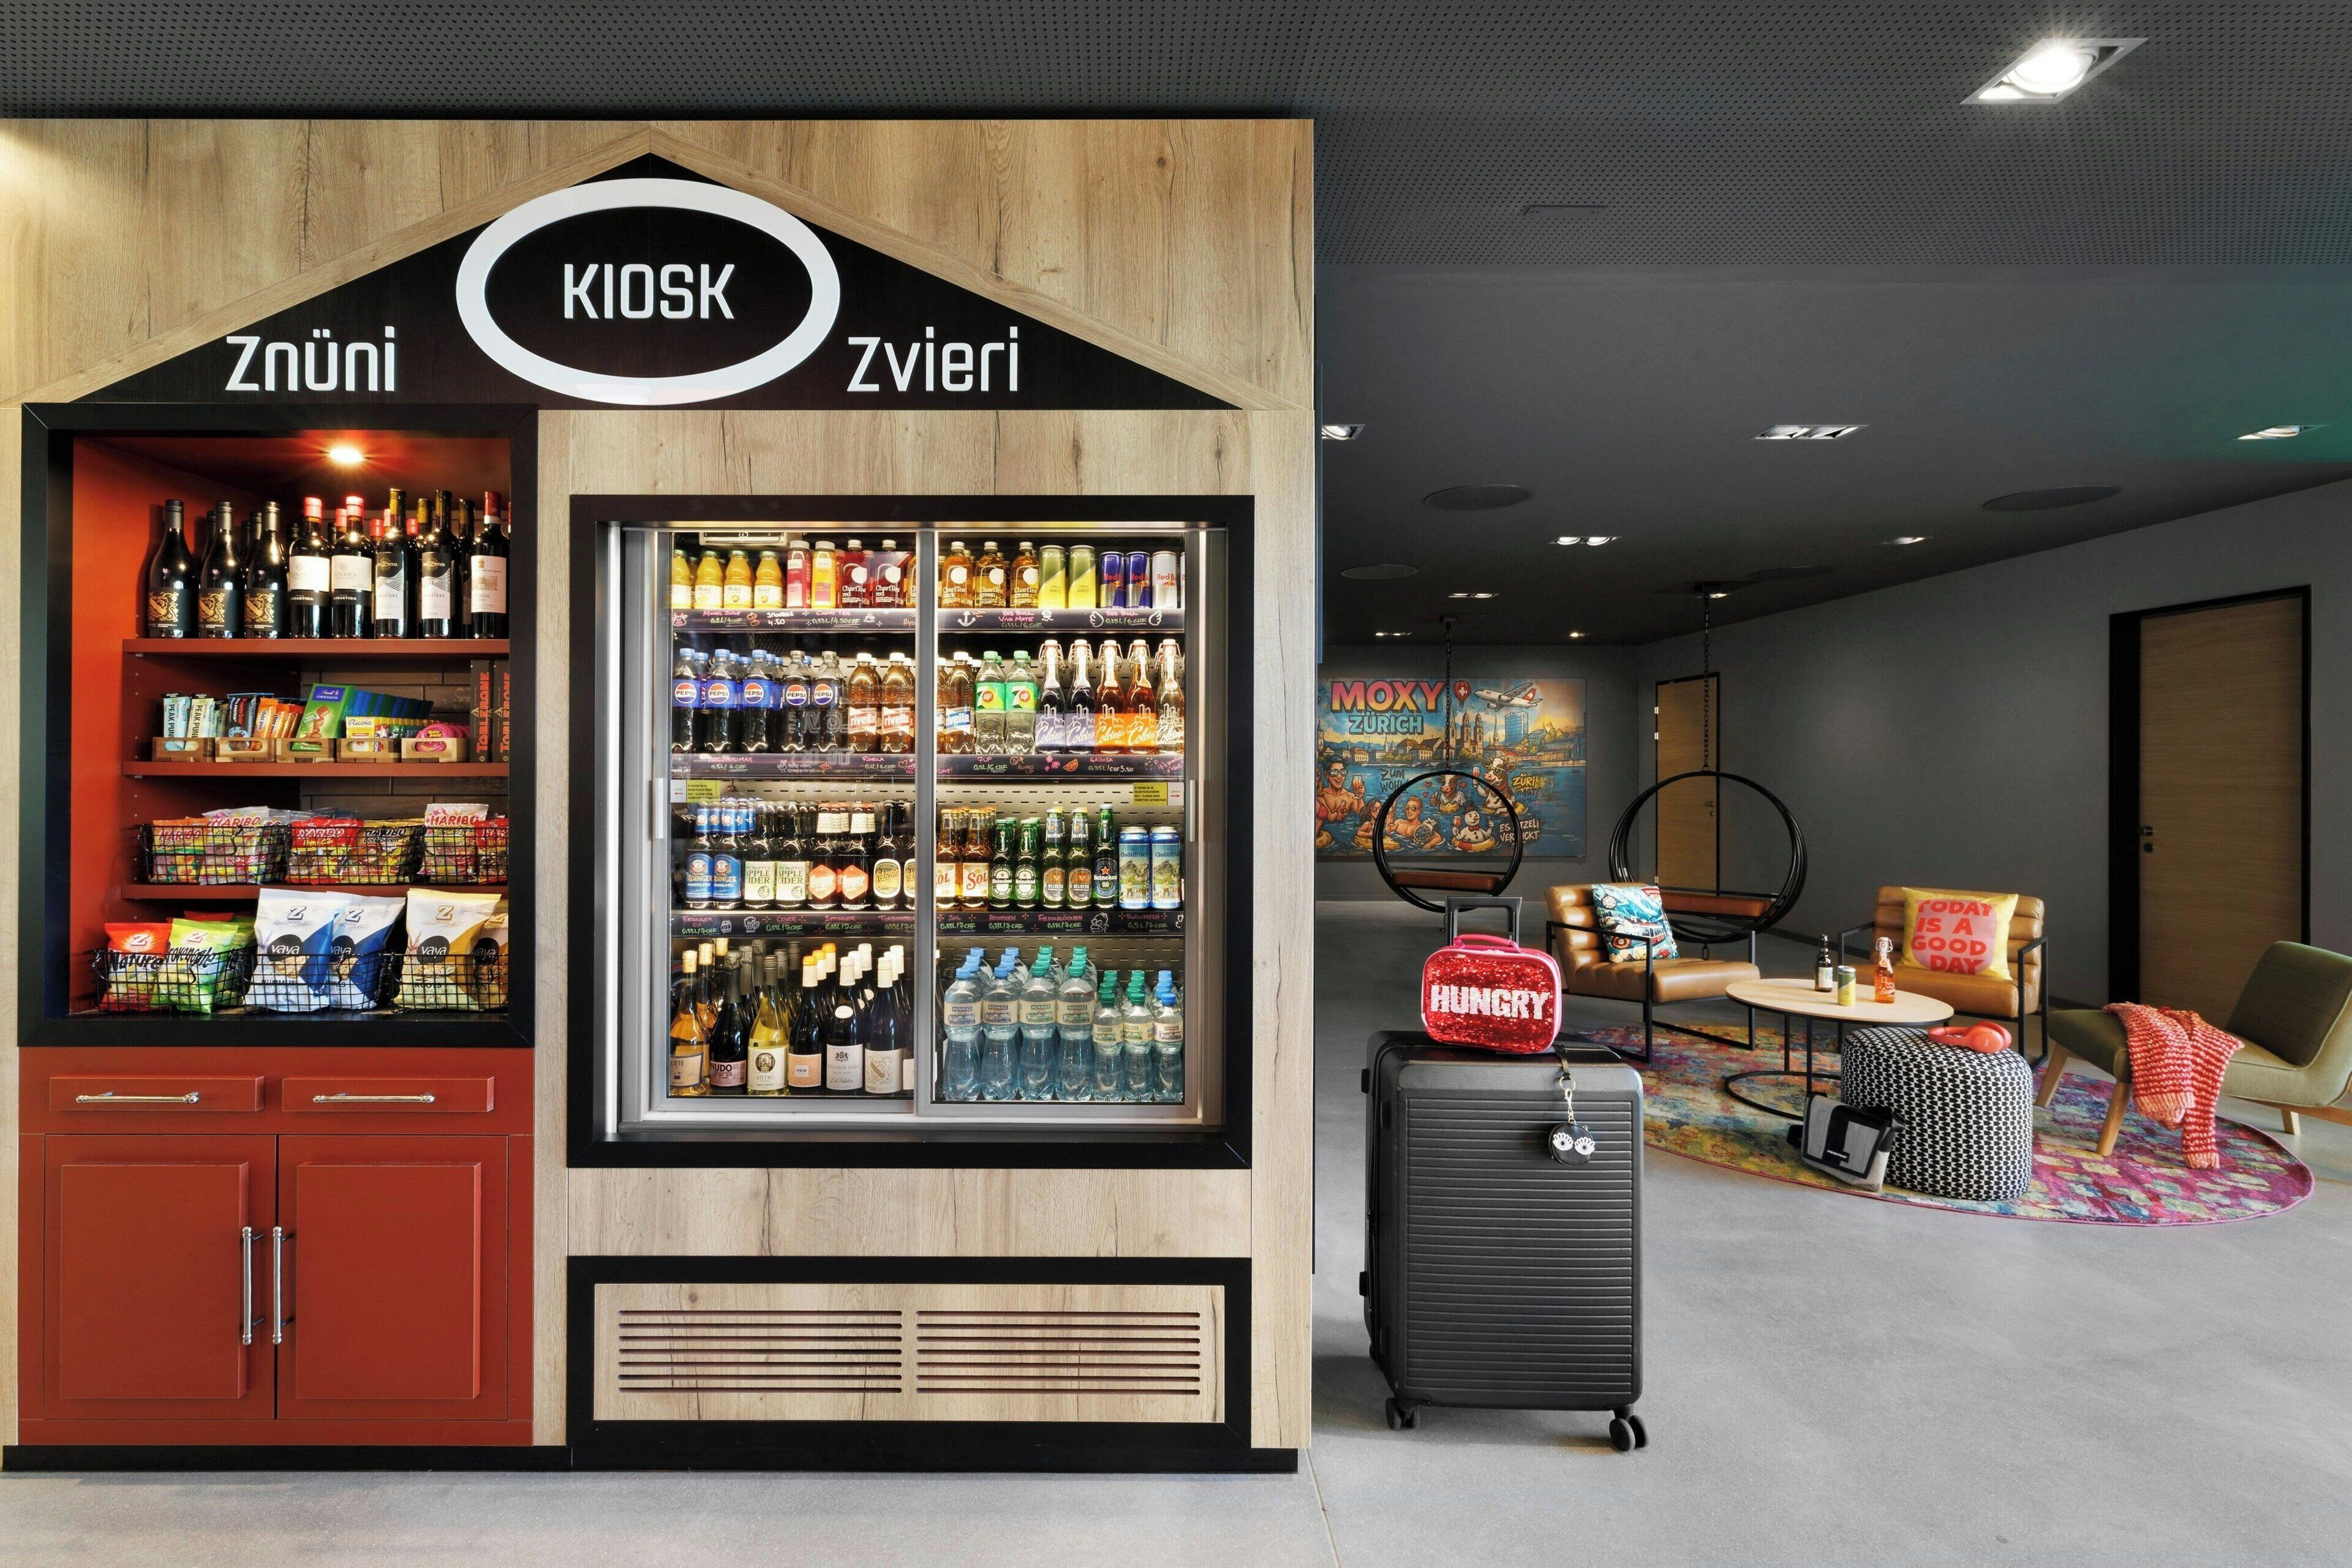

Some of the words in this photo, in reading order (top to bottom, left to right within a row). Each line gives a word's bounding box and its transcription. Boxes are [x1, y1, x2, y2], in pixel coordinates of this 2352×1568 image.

[564, 263, 734, 318] KIOSK
[227, 326, 394, 392] Znüni
[848, 326, 1018, 392] Zvieri
[1331, 680, 1446, 713] MOXY
[477, 672, 489, 753] TOBLERONE
[850, 713, 876, 725] rivella
[884, 714, 910, 725] rivella
[946, 714, 970, 726] ivella
[1349, 711, 1423, 734] ZÜRICH
[213, 816, 262, 827] HARIBO
[1499, 823, 1511, 832] ES
[1917, 900, 1994, 917] TODAY
[1917, 918, 1942, 933] IS
[1953, 918, 1973, 936] A
[271, 943, 300, 954] vaya
[421, 945, 447, 957] vaya
[1911, 935, 1987, 956] GOOD
[1930, 955, 1985, 975] DAY
[1431, 984, 1550, 1019] HUNGRY
